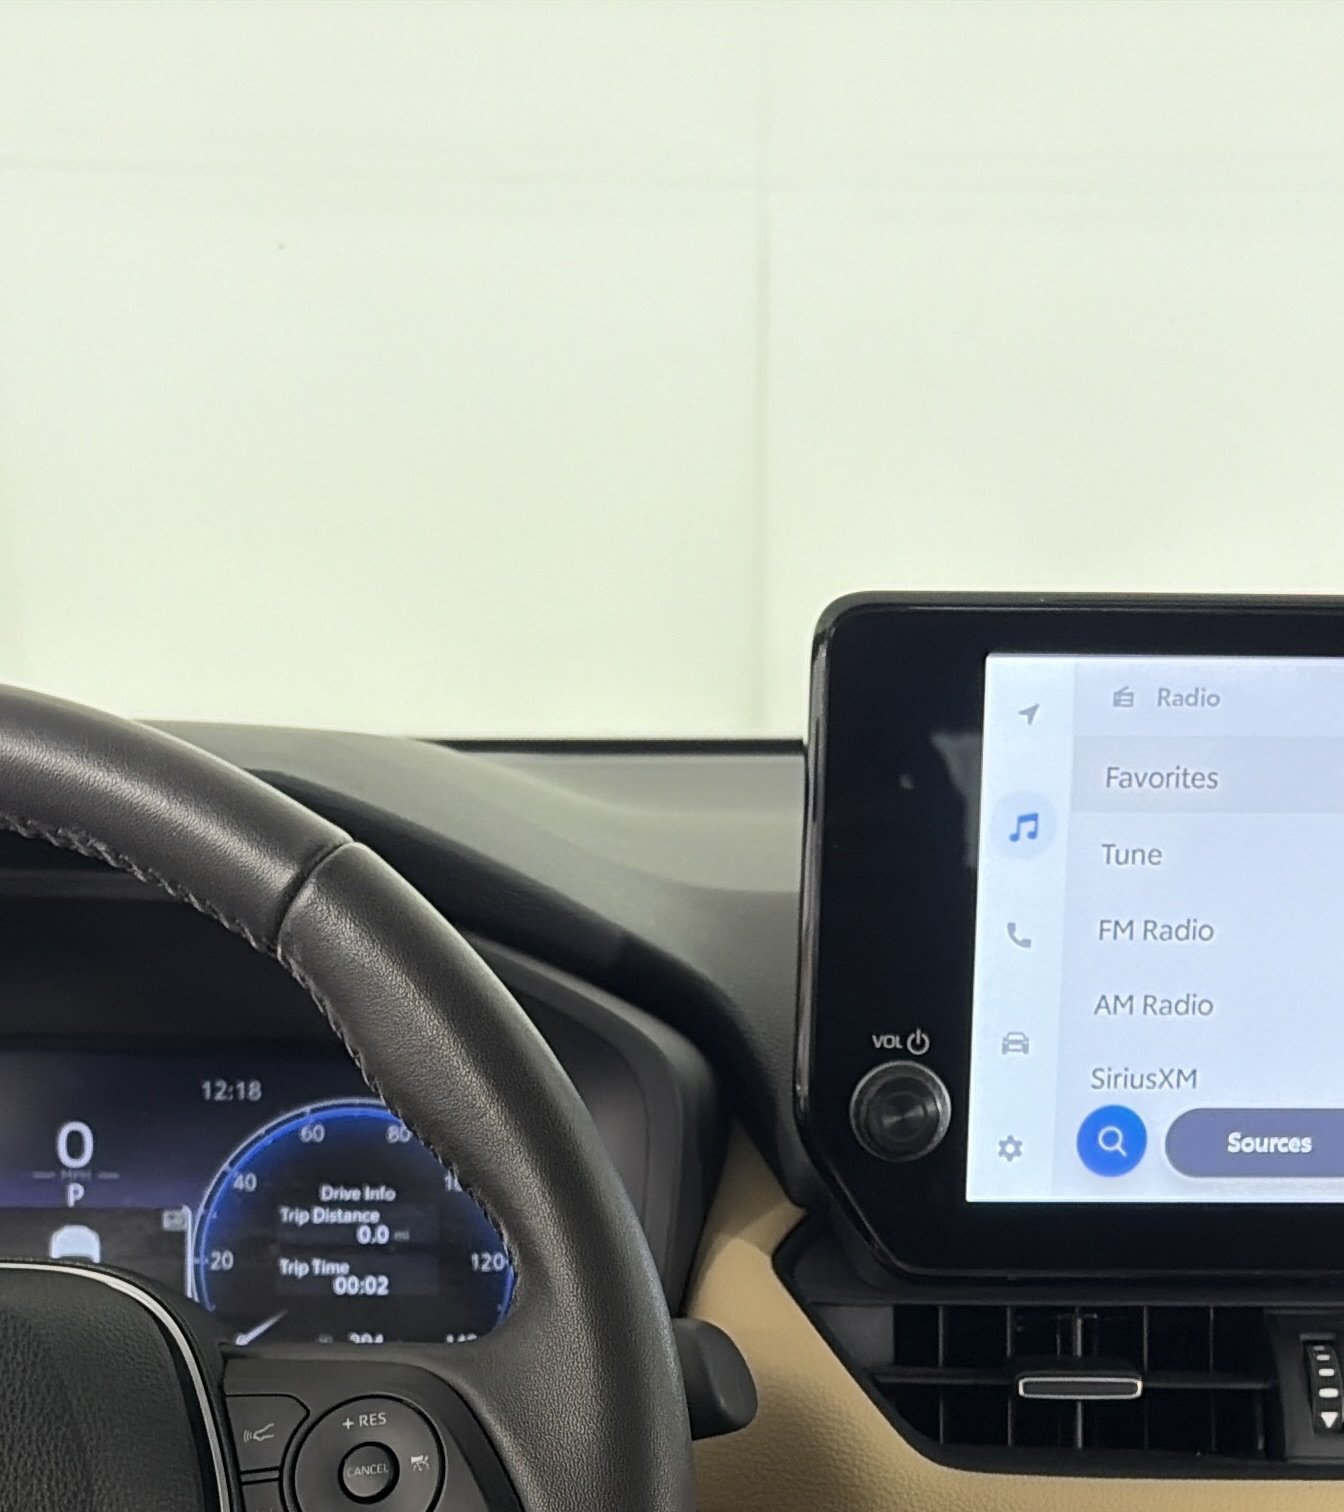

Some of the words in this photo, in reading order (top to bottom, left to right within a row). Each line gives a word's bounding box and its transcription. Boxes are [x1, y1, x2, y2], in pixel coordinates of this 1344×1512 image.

[1156, 686, 1222, 709] Radio
[1104, 764, 1220, 791] Favorites
[1101, 843, 1164, 867] Tune
[1097, 918, 1135, 942] FM
[1142, 917, 1216, 942] Radio
[1092, 993, 1135, 1017] AM
[1142, 992, 1215, 1017] Radio
[871, 1034, 904, 1049] VOL
[201, 1078, 263, 1101] 12:18
[1089, 1066, 1198, 1091] SiriusXM
[56, 1120, 94, 1170] 0
[299, 1123, 326, 1144] 60
[387, 1123, 411, 1144] 80
[1226, 1131, 1314, 1154] Sources
[232, 1172, 258, 1193] 40
[319, 1184, 362, 1203] Drive
[364, 1184, 397, 1203] Info
[66, 1182, 86, 1207] P
[278, 1205, 310, 1227] Trip
[312, 1206, 381, 1225] Distance
[355, 1224, 391, 1246] 0.0
[209, 1249, 235, 1272] 20
[278, 1257, 309, 1279] Trip
[312, 1257, 351, 1276] Time
[470, 1252, 507, 1273] 120
[332, 1274, 390, 1297] 00:02
[358, 1411, 388, 1428] RES
[346, 1462, 390, 1477] CANCEL
